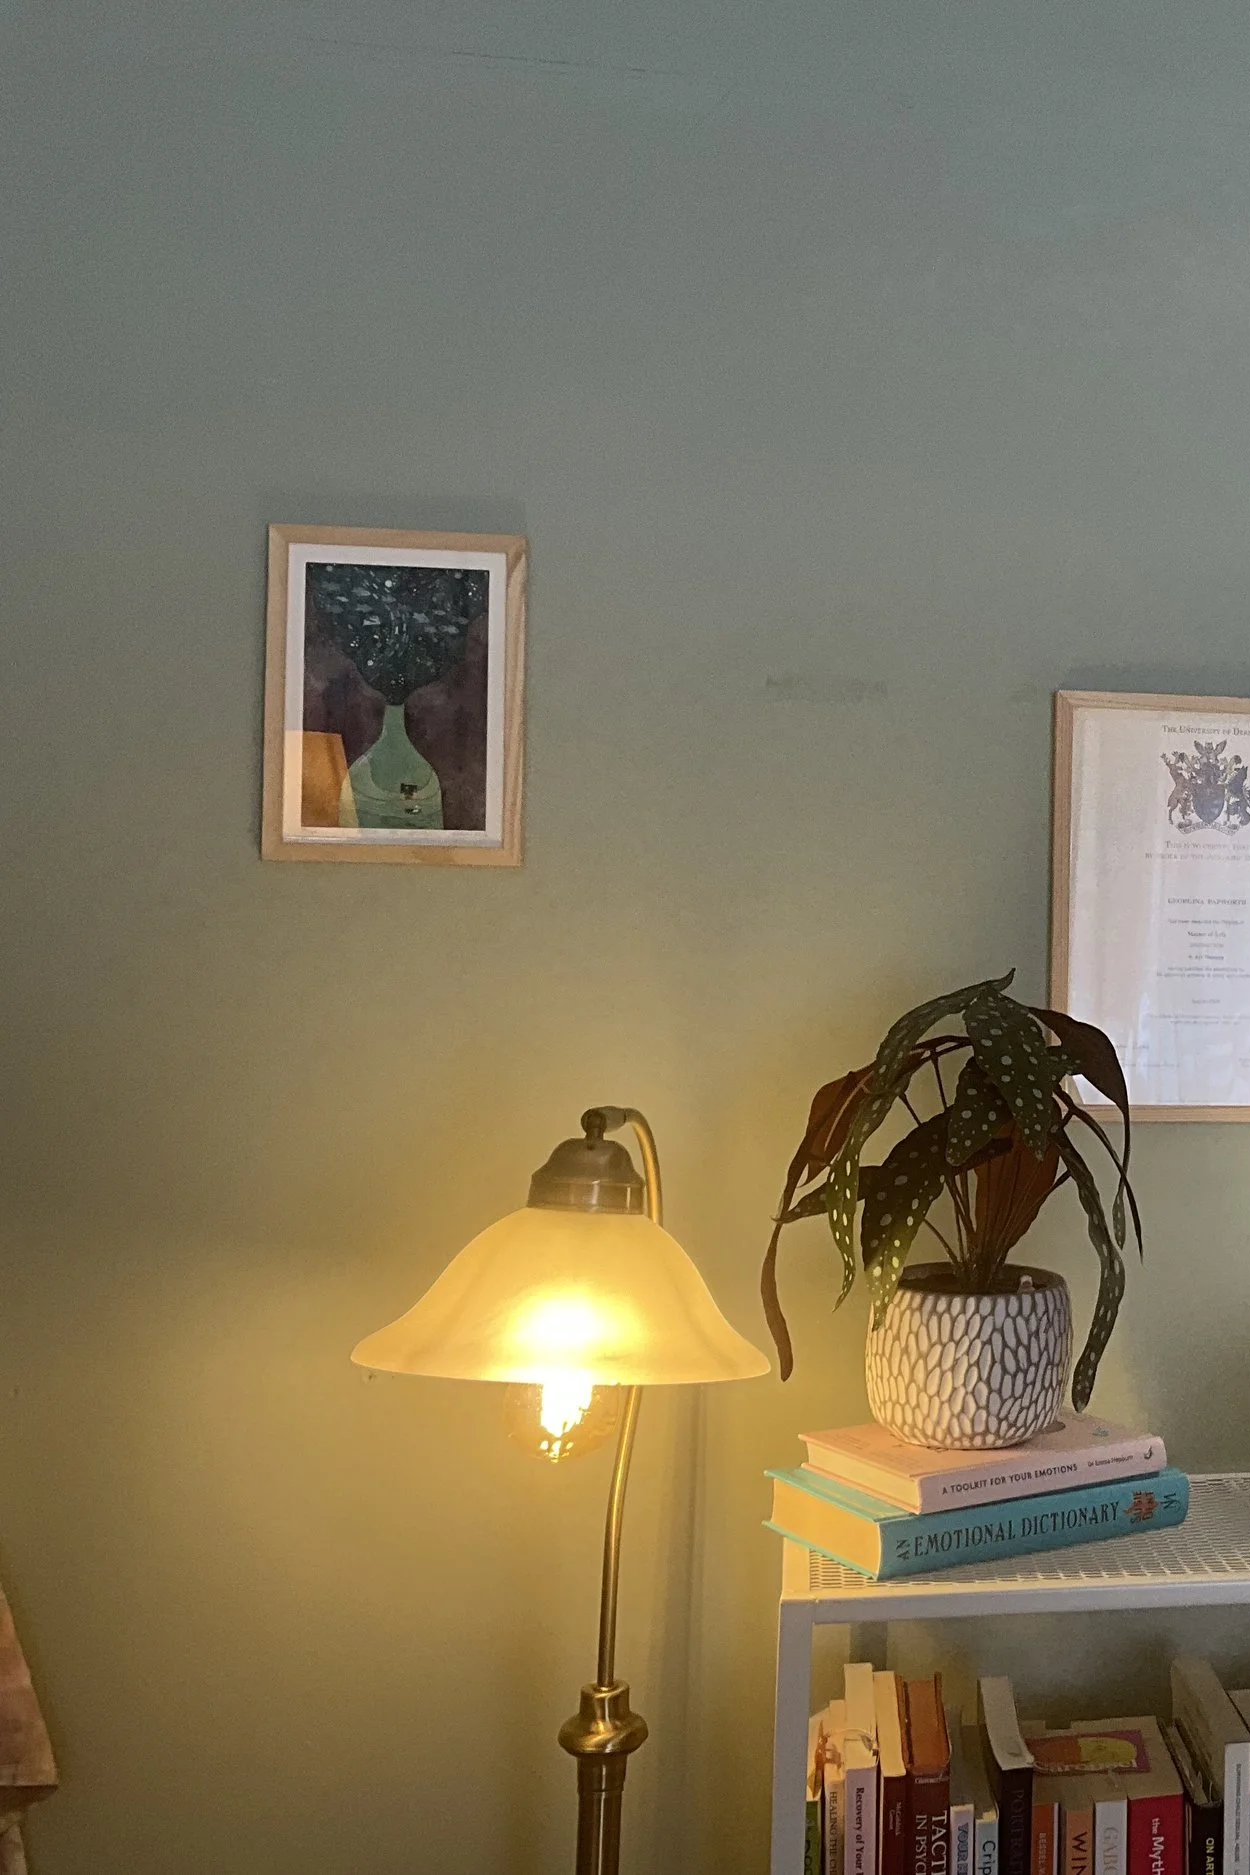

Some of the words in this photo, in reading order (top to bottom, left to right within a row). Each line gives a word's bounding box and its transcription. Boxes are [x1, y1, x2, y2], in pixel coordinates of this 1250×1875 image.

[942, 1486, 948, 1495] A
[950, 1479, 988, 1494] TOOLKIT
[990, 1476, 1006, 1486] FOR
[1008, 1471, 1033, 1483] YOUR
[1034, 1463, 1078, 1479] EMOTIONS
[914, 1519, 1016, 1557] EMOTIONAL
[1021, 1501, 1119, 1537] DICTIONARY
[829, 1791, 838, 1836] HEALING
[853, 1787, 865, 1833] Recovery
[915, 1815, 928, 1830] IN
[1151, 1818, 1160, 1834] the
[829, 1840, 838, 1857] THE
[855, 1834, 865, 1844] of
[1206, 1838, 1215, 1853] ON
[855, 1846, 865, 1869] Your
[1149, 1836, 1164, 1875] Myth
[1206, 1856, 1215, 1875] ART
